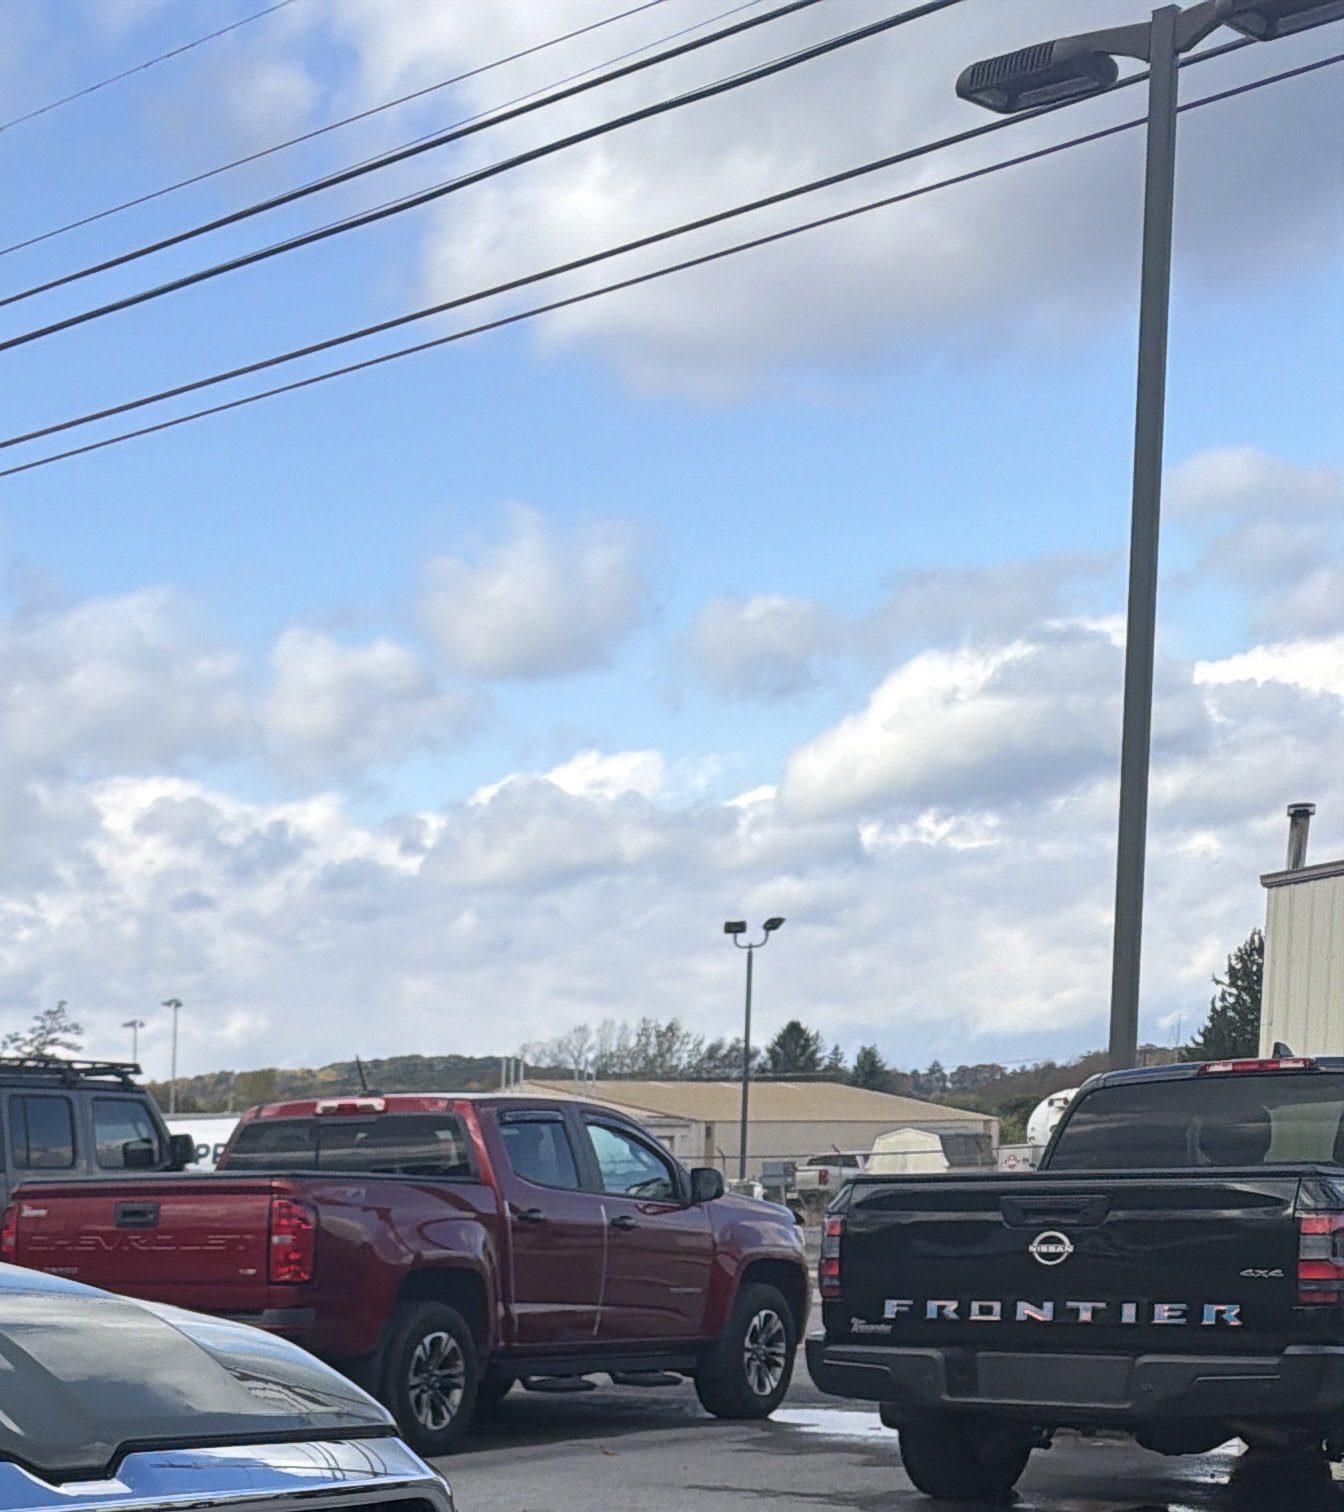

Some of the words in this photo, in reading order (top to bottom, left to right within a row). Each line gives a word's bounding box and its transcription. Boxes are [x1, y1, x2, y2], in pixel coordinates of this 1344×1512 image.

[28, 1235, 255, 1249] CHEVROLET
[1028, 1244, 1074, 1253] NISSAN
[884, 1299, 1243, 1326] FRONTIER
